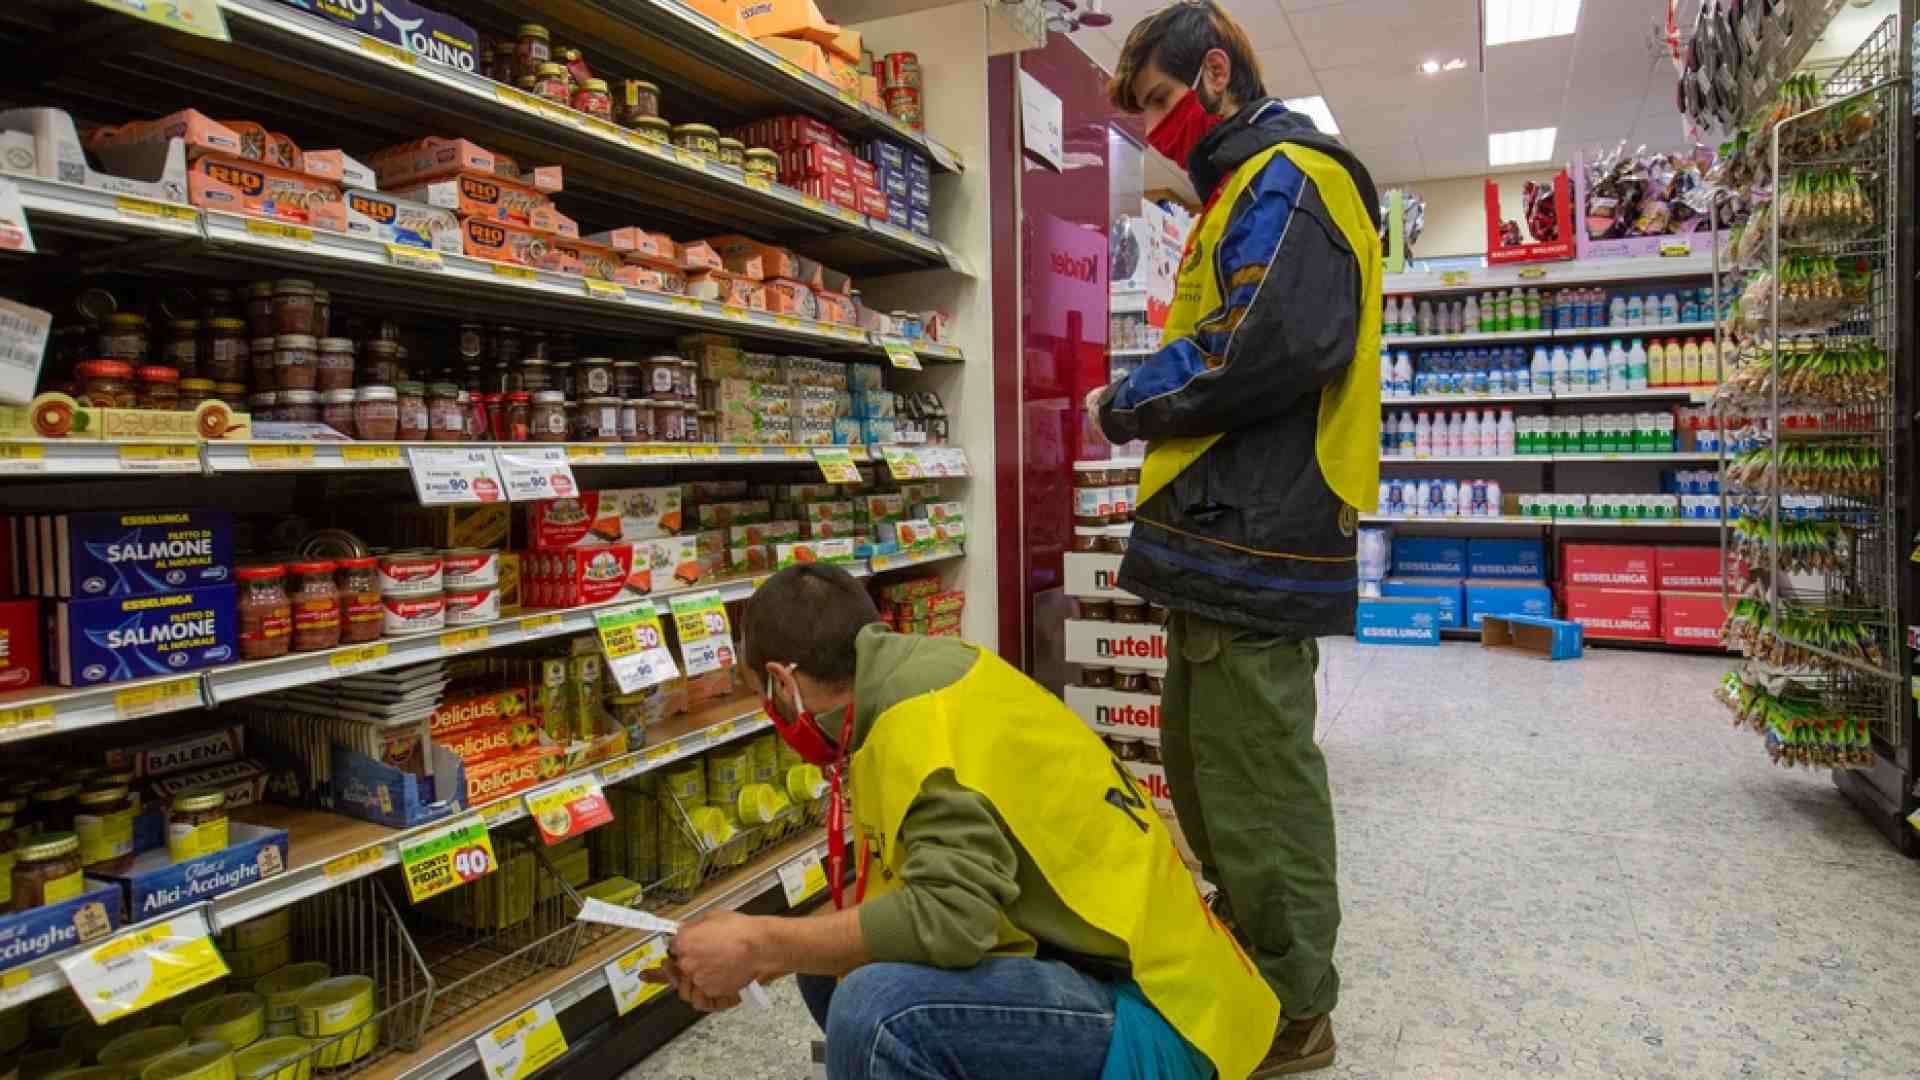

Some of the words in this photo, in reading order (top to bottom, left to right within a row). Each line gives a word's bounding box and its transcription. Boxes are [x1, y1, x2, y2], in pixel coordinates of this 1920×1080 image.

[207, 164, 262, 196] RIO
[351, 197, 394, 222] RIO
[107, 538, 213, 562] SALMONE
[1572, 572, 1649, 585] ESSELUNGA
[121, 595, 193, 611] ESSELUNGA
[107, 618, 216, 649] SALMONE
[1362, 626, 1433, 639] ESSELUNGA
[1574, 616, 1649, 630] ESSELUNGA
[1096, 635, 1168, 658] nutell
[429, 702, 497, 729] Delicius
[150, 741, 233, 769] BALENA
[467, 767, 535, 797] Delicius
[409, 854, 450, 874] SCONTO
[455, 848, 487, 873] 40
